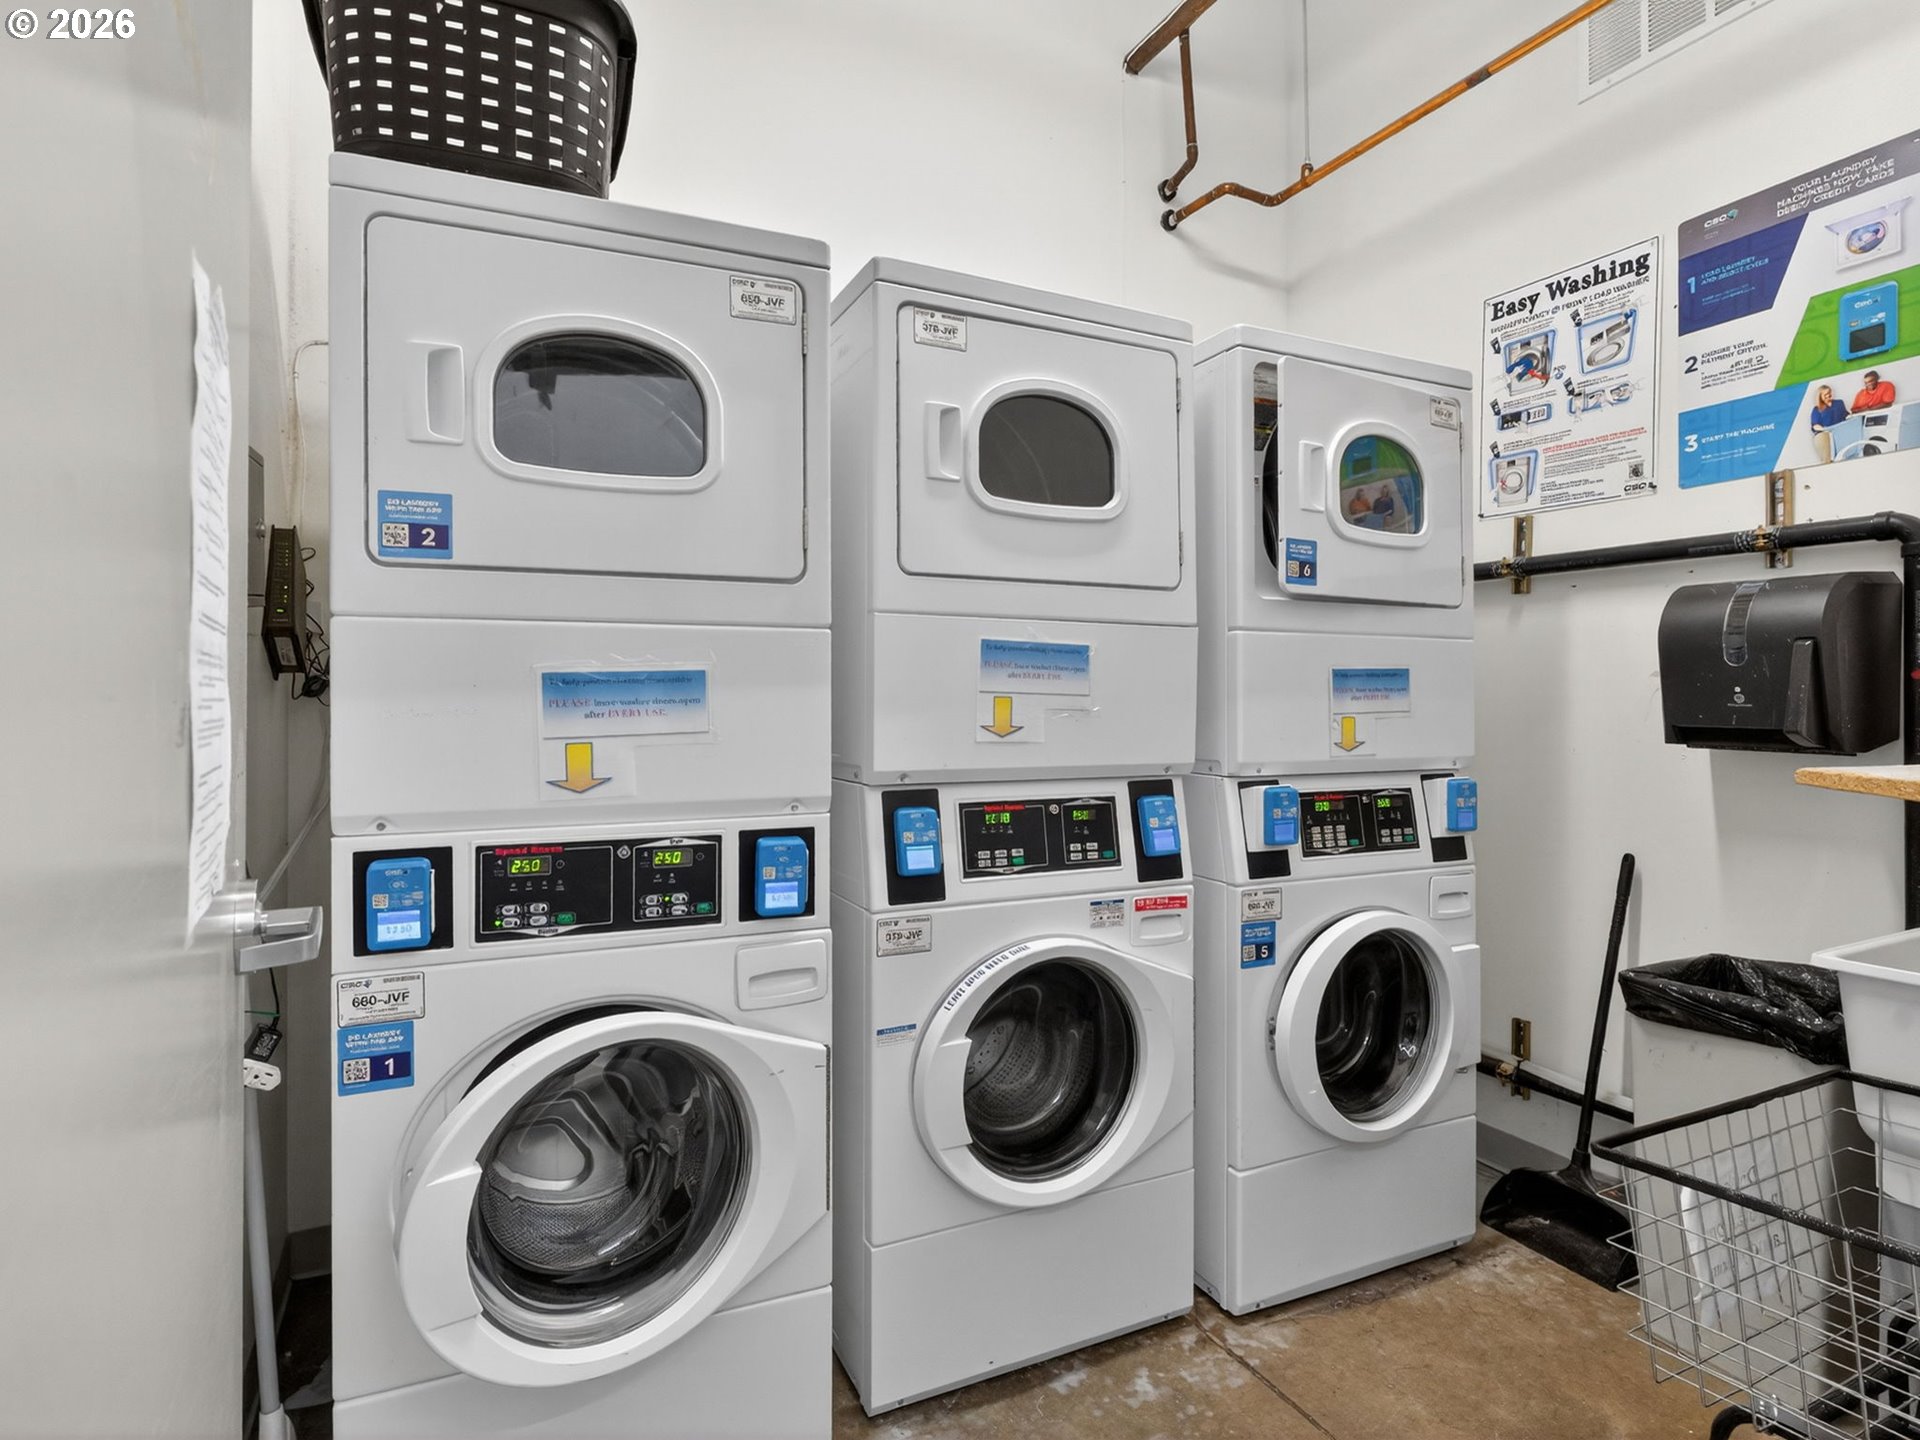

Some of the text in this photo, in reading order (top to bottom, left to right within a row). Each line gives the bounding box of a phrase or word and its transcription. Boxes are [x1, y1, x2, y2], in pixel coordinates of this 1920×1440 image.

[1491, 292, 1541, 322] Easy
[1545, 252, 1651, 302] Washing
[1687, 276, 1696, 294] 1
[1684, 355, 1698, 374] 2
[1684, 433, 1698, 453] 3
[421, 527, 436, 547] 2
[1303, 564, 1311, 577] 6
[1260, 945, 1269, 958] 5
[384, 1057, 395, 1076] 1
